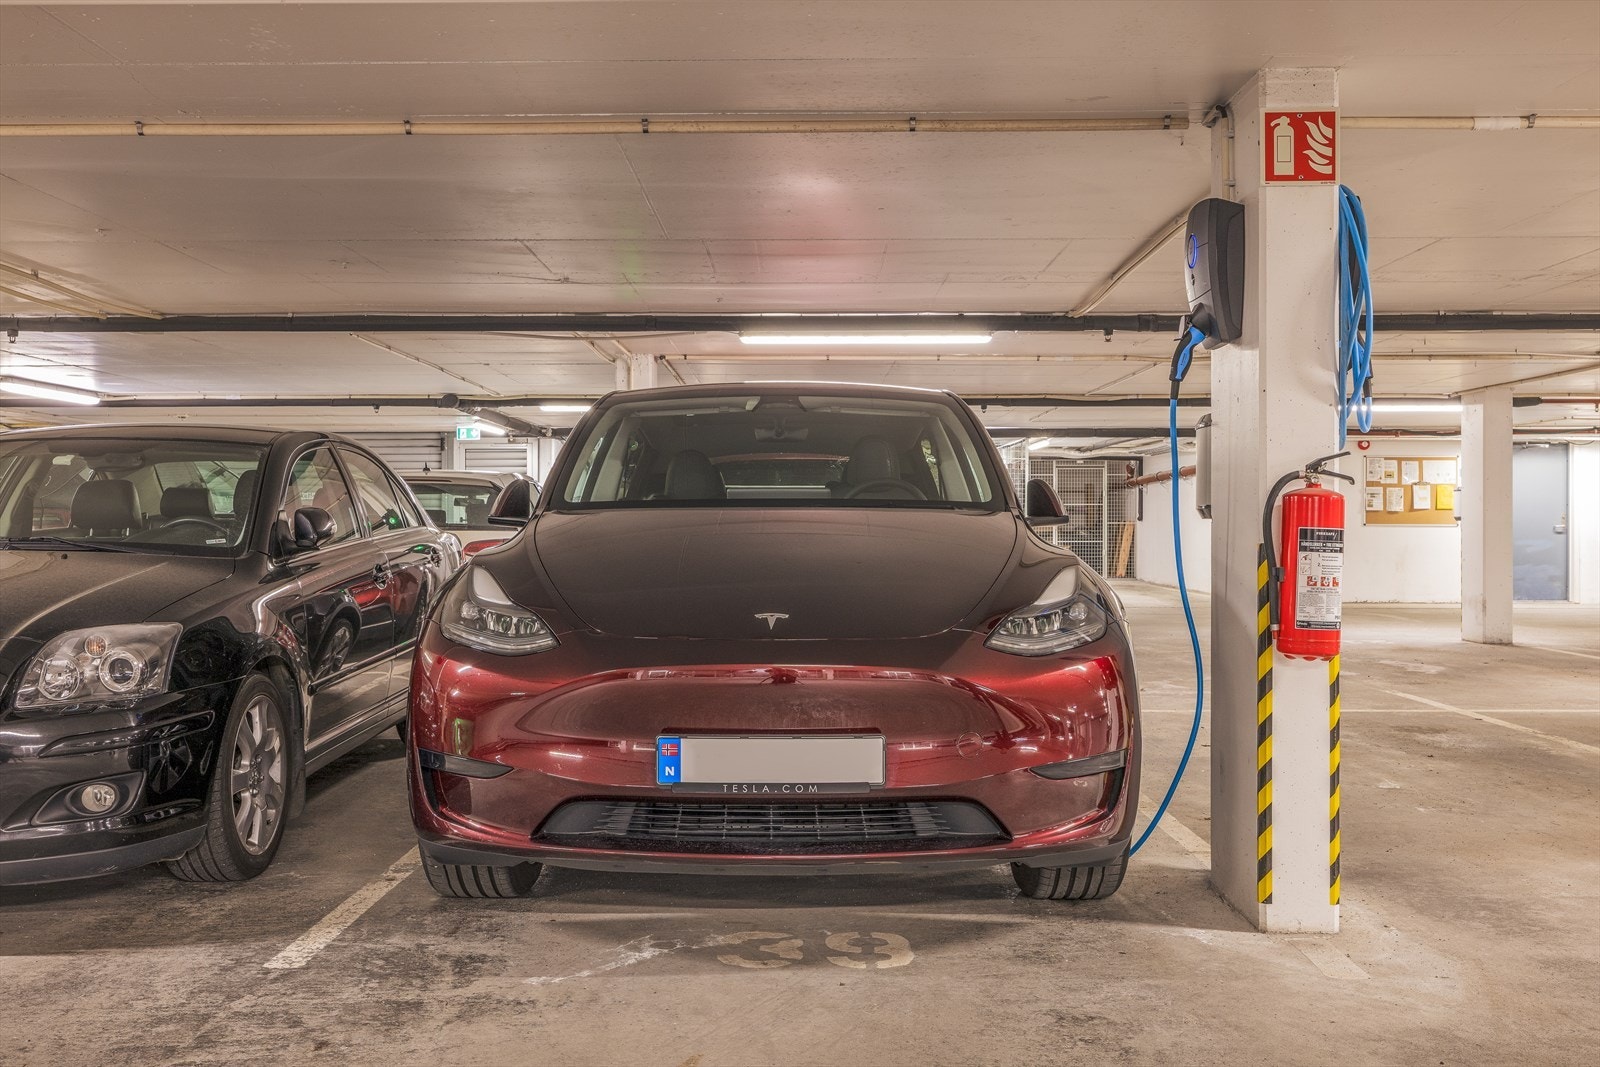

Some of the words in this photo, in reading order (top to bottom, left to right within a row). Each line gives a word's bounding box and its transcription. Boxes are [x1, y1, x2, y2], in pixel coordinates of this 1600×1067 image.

[665, 766, 675, 776] N
[723, 784, 819, 793] TESLA.COM
[716, 930, 915, 969] 39
